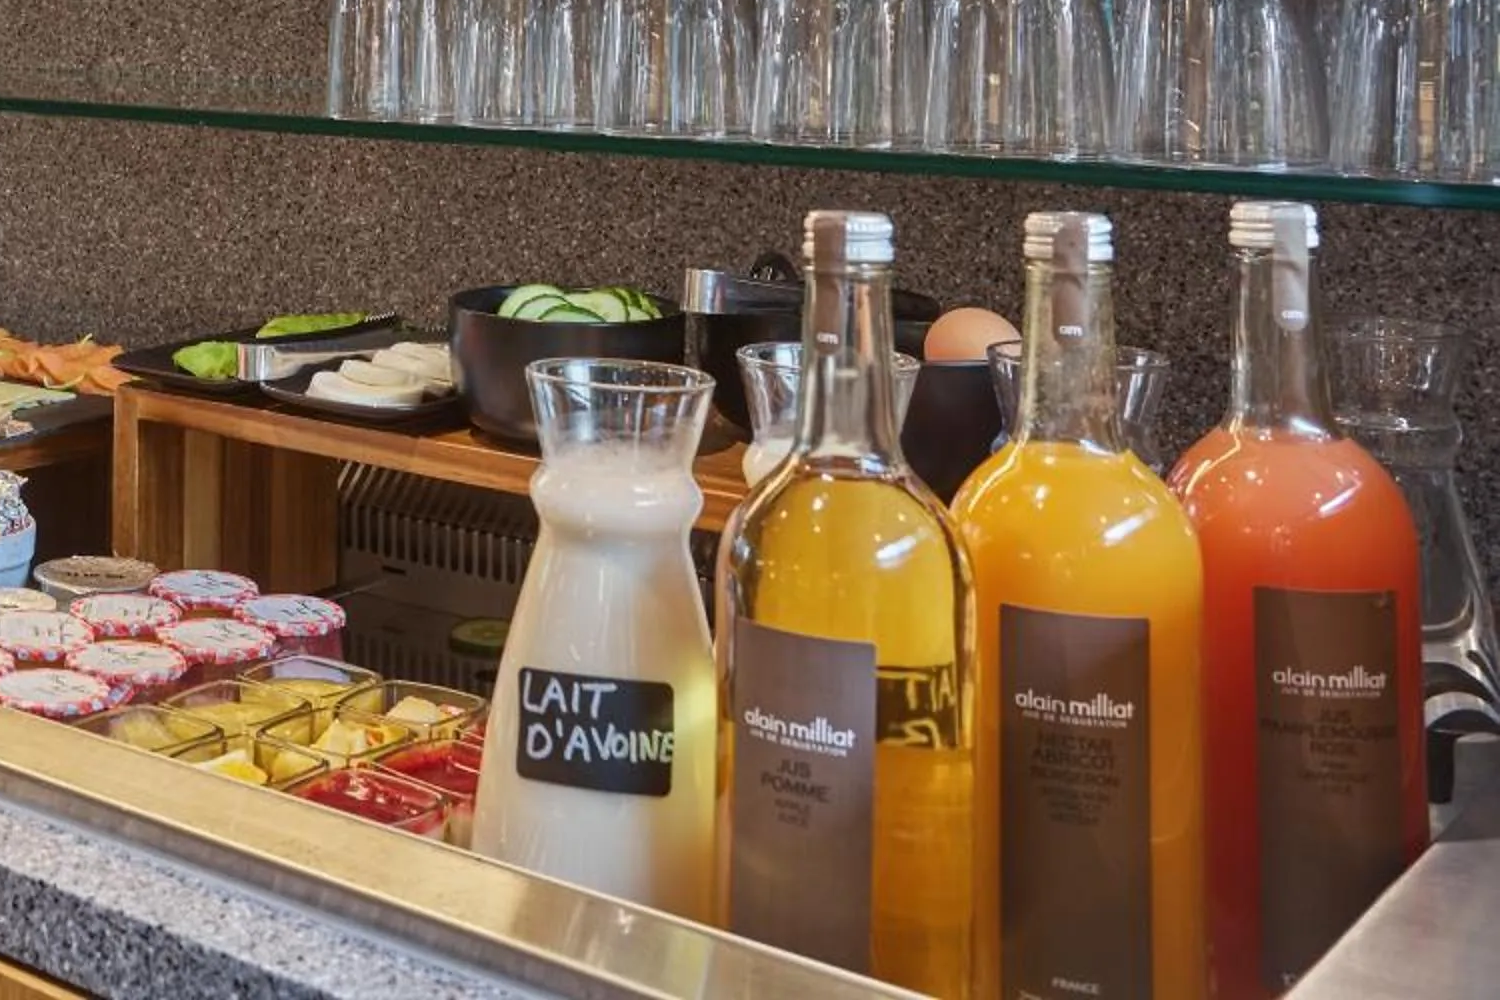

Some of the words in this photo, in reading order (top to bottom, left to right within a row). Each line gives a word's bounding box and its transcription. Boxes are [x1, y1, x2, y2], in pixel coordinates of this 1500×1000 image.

[522, 671, 618, 720] LAIT
[1272, 665, 1325, 689] alain
[1327, 664, 1388, 690] milliat
[1014, 687, 1067, 714] alain
[1068, 692, 1136, 719] milliat
[525, 718, 675, 764] D'AVOINE
[743, 706, 787, 734] alain
[789, 715, 858, 750] milliat
[760, 769, 831, 804] POMME
